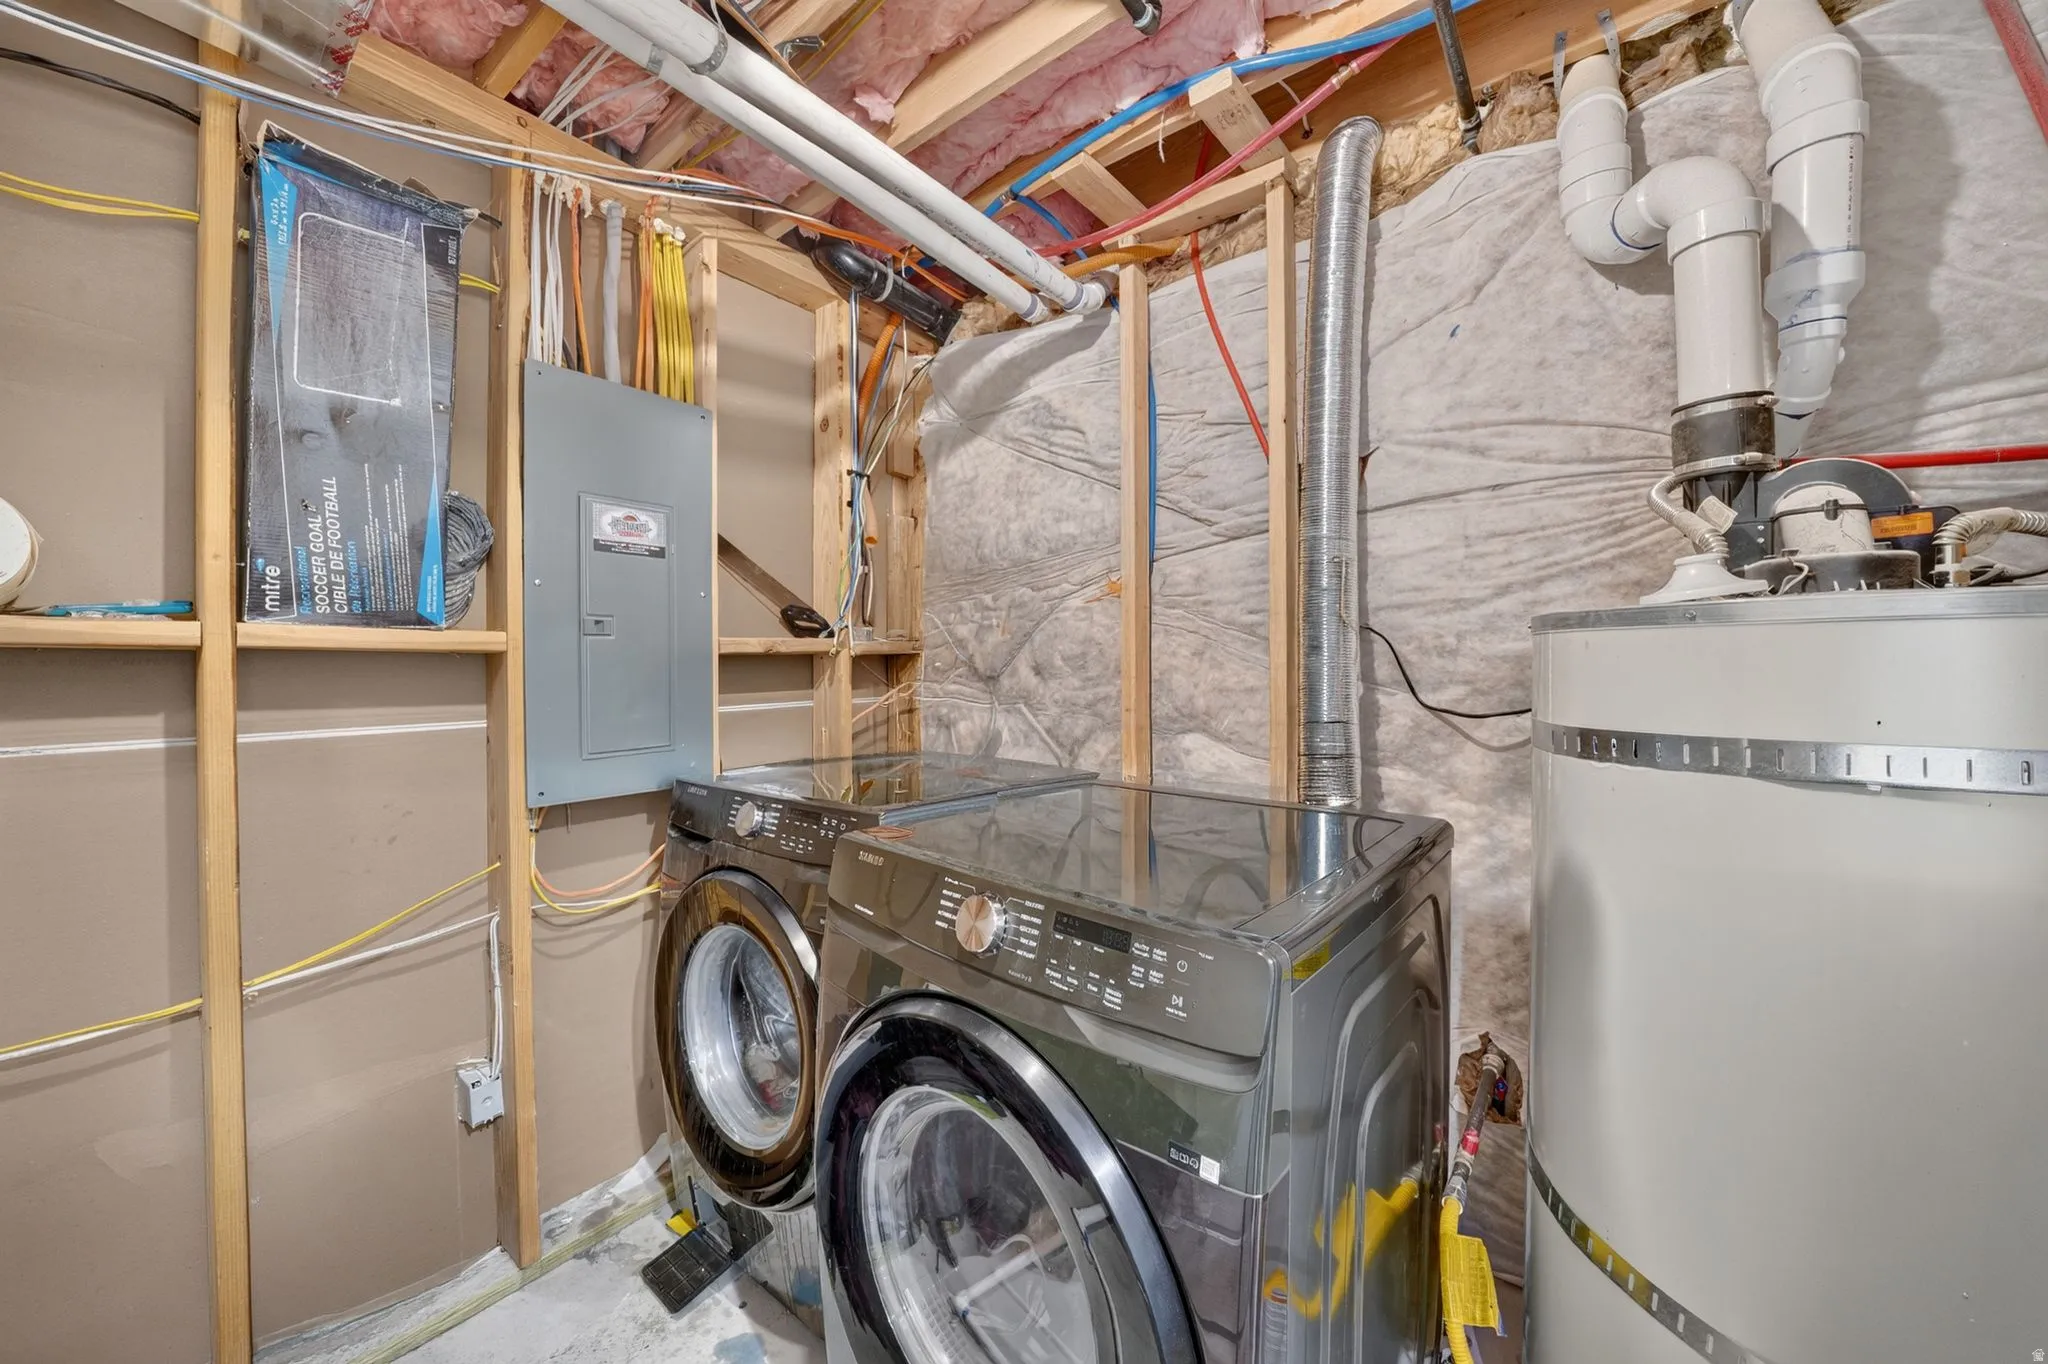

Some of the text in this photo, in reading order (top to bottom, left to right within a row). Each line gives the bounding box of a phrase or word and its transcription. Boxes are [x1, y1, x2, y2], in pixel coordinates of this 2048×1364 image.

[261, 565, 281, 612] mitre
[307, 514, 331, 614] SOCCER GOAL
[321, 476, 348, 614] CIBLE DE FOOTBALL
